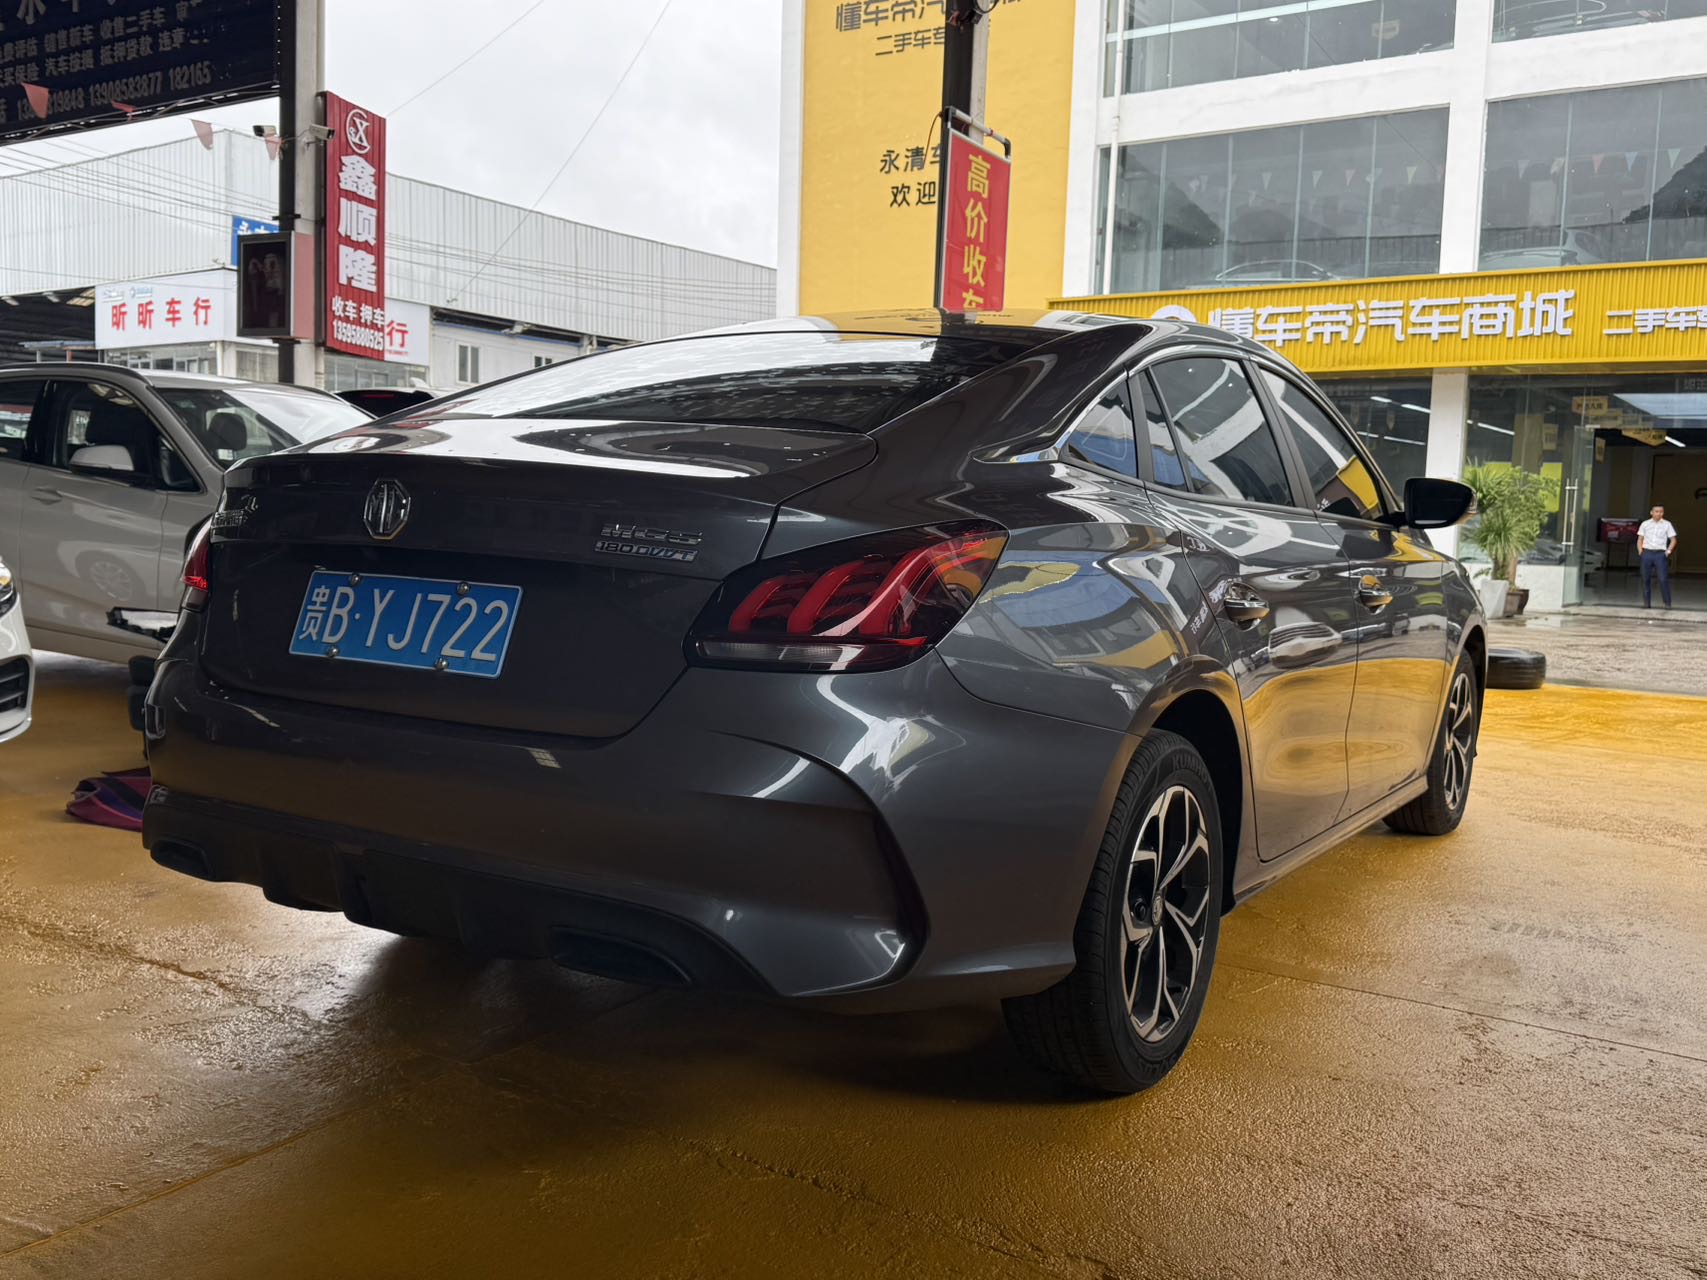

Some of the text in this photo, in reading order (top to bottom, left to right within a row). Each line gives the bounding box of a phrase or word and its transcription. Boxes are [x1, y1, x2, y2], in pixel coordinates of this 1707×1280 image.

[337, 154, 378, 293] 鑫顺隆
[332, 295, 386, 329] 收车 押车
[386, 320, 409, 349] 行
[1208, 288, 1575, 347] 懂车帝汽车商城
